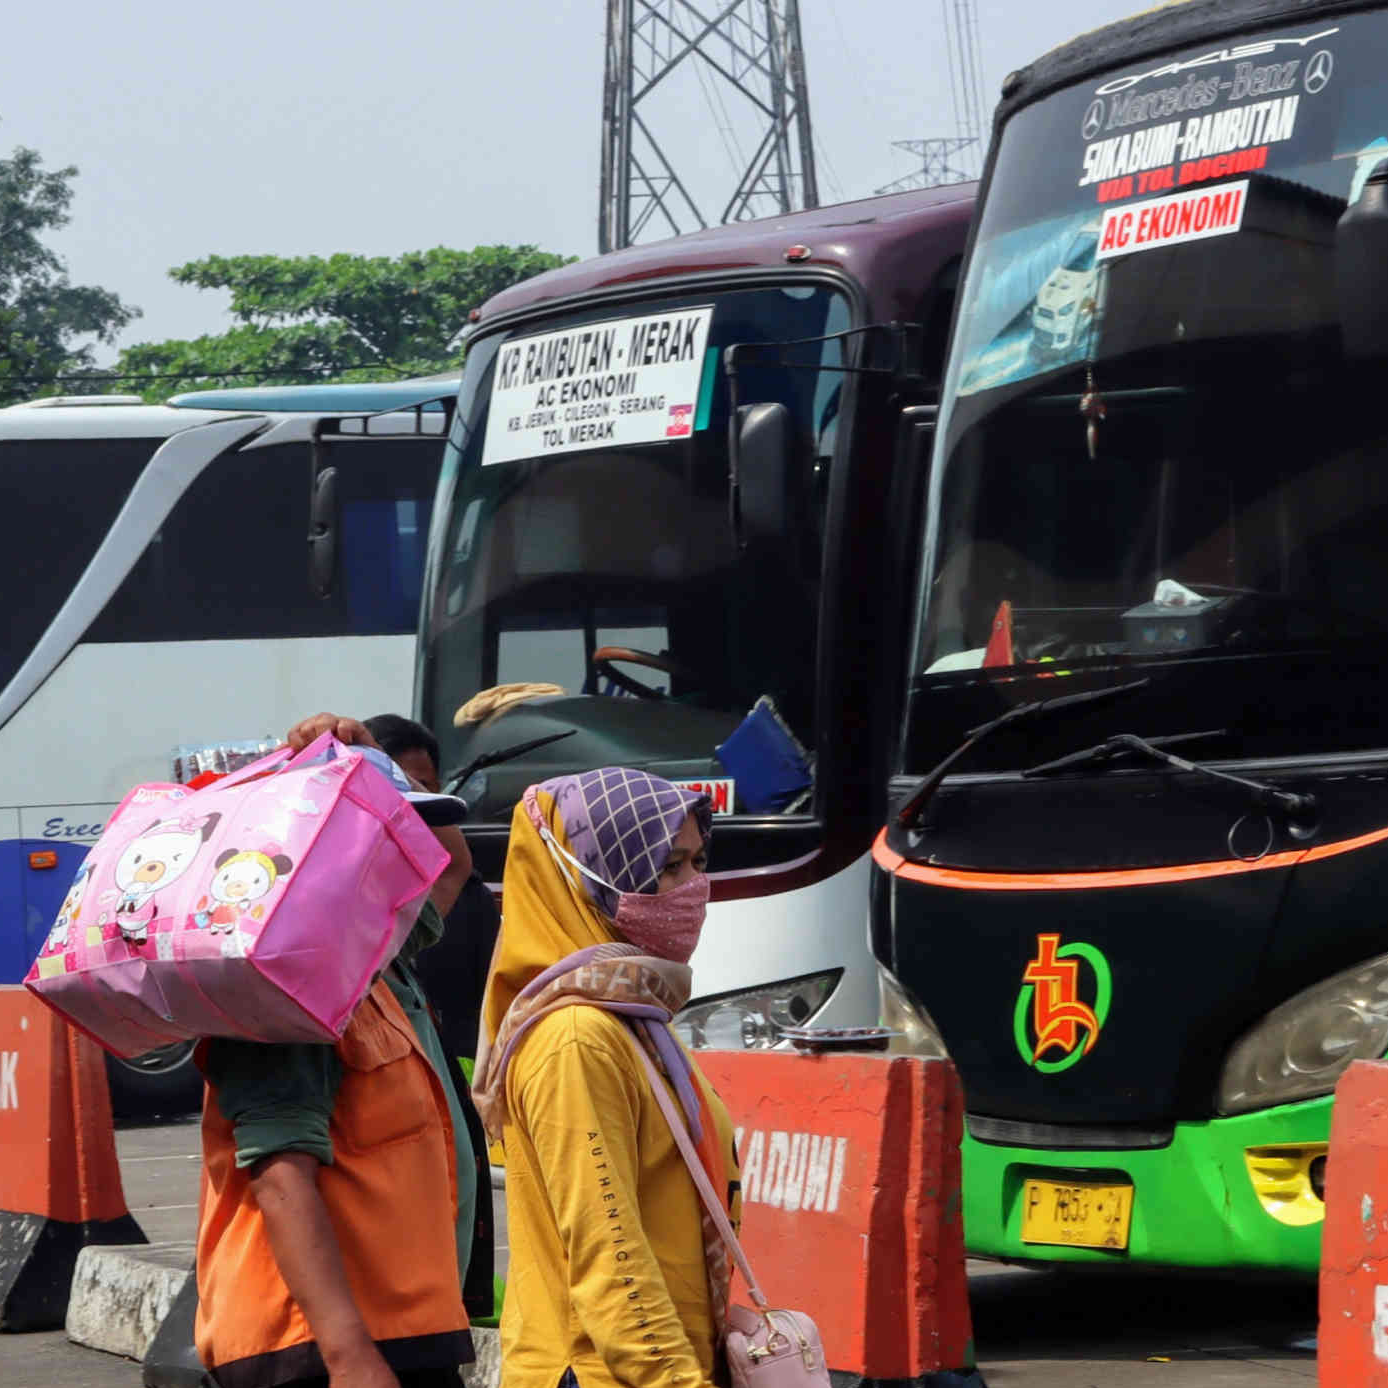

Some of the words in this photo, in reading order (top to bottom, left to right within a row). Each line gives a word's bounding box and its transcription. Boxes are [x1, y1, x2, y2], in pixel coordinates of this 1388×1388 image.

[1105, 60, 1301, 130] Mercedes-Benz
[1100, 212, 1133, 251] AC
[1134, 189, 1243, 243] EKONOMI
[523, 327, 616, 385] RAMBUTAN
[627, 316, 702, 367] MERAK
[525, 410, 556, 428] JERUK
[565, 403, 611, 421] CILEGON
[619, 395, 665, 415] SERANG
[535, 383, 556, 409] AC
[560, 371, 638, 404] EKONOMI
[543, 428, 564, 448] TOL
[569, 420, 616, 442] MERAK
[586, 1130, 629, 1264] AUTHENTIC
